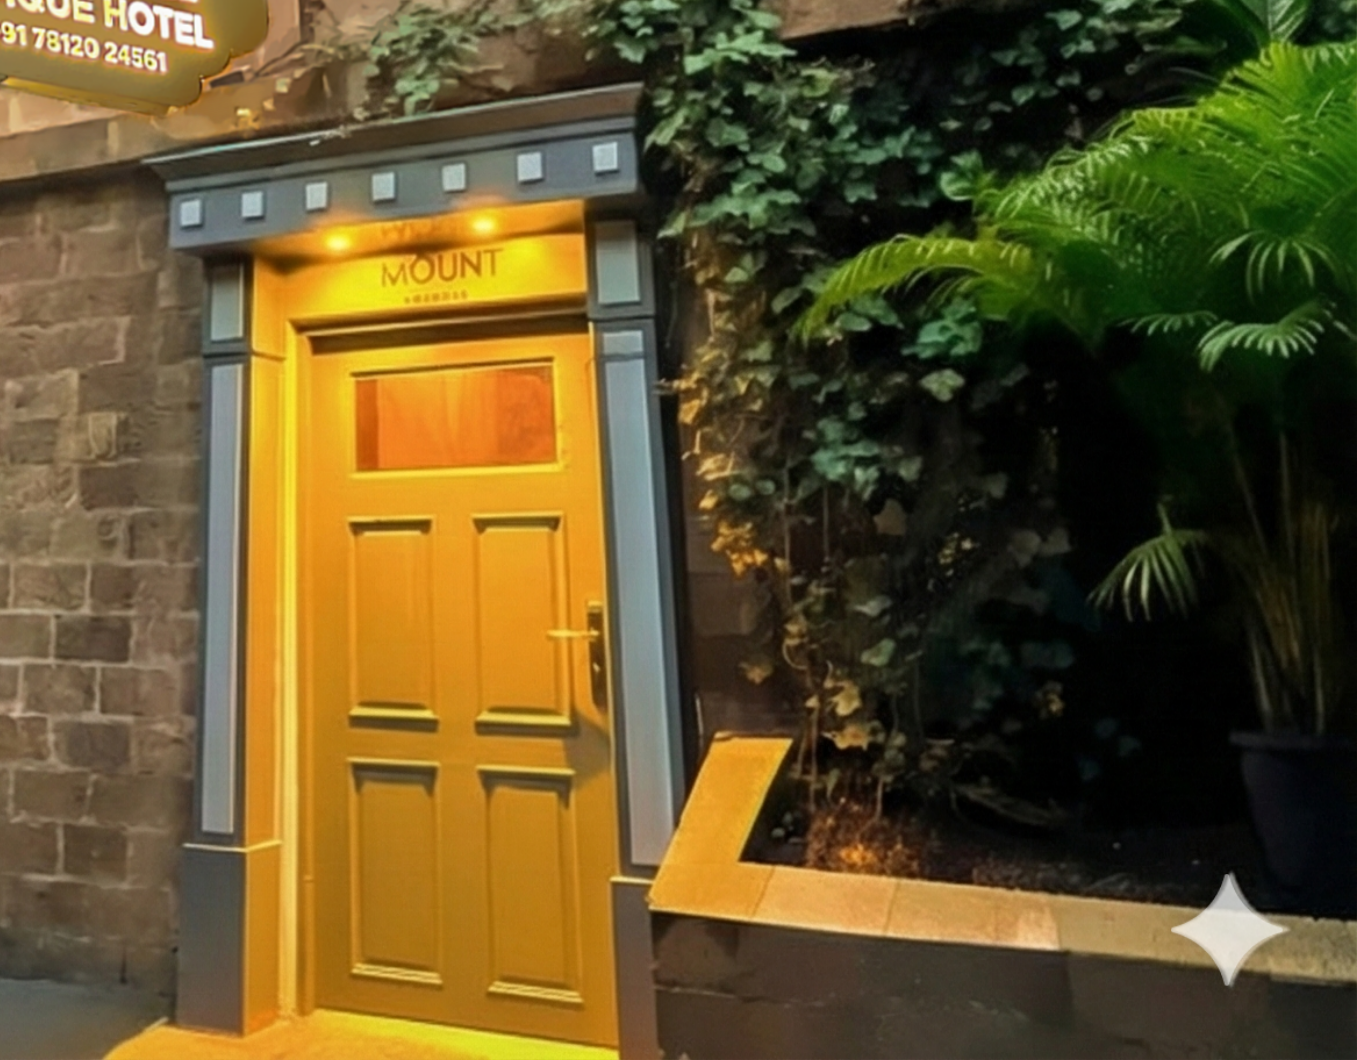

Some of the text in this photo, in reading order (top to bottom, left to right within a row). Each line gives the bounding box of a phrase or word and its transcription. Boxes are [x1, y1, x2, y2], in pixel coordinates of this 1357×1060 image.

[31, 26, 101, 60] 78120
[103, 40, 168, 74] 24561
[381, 247, 504, 288] MOUNT
